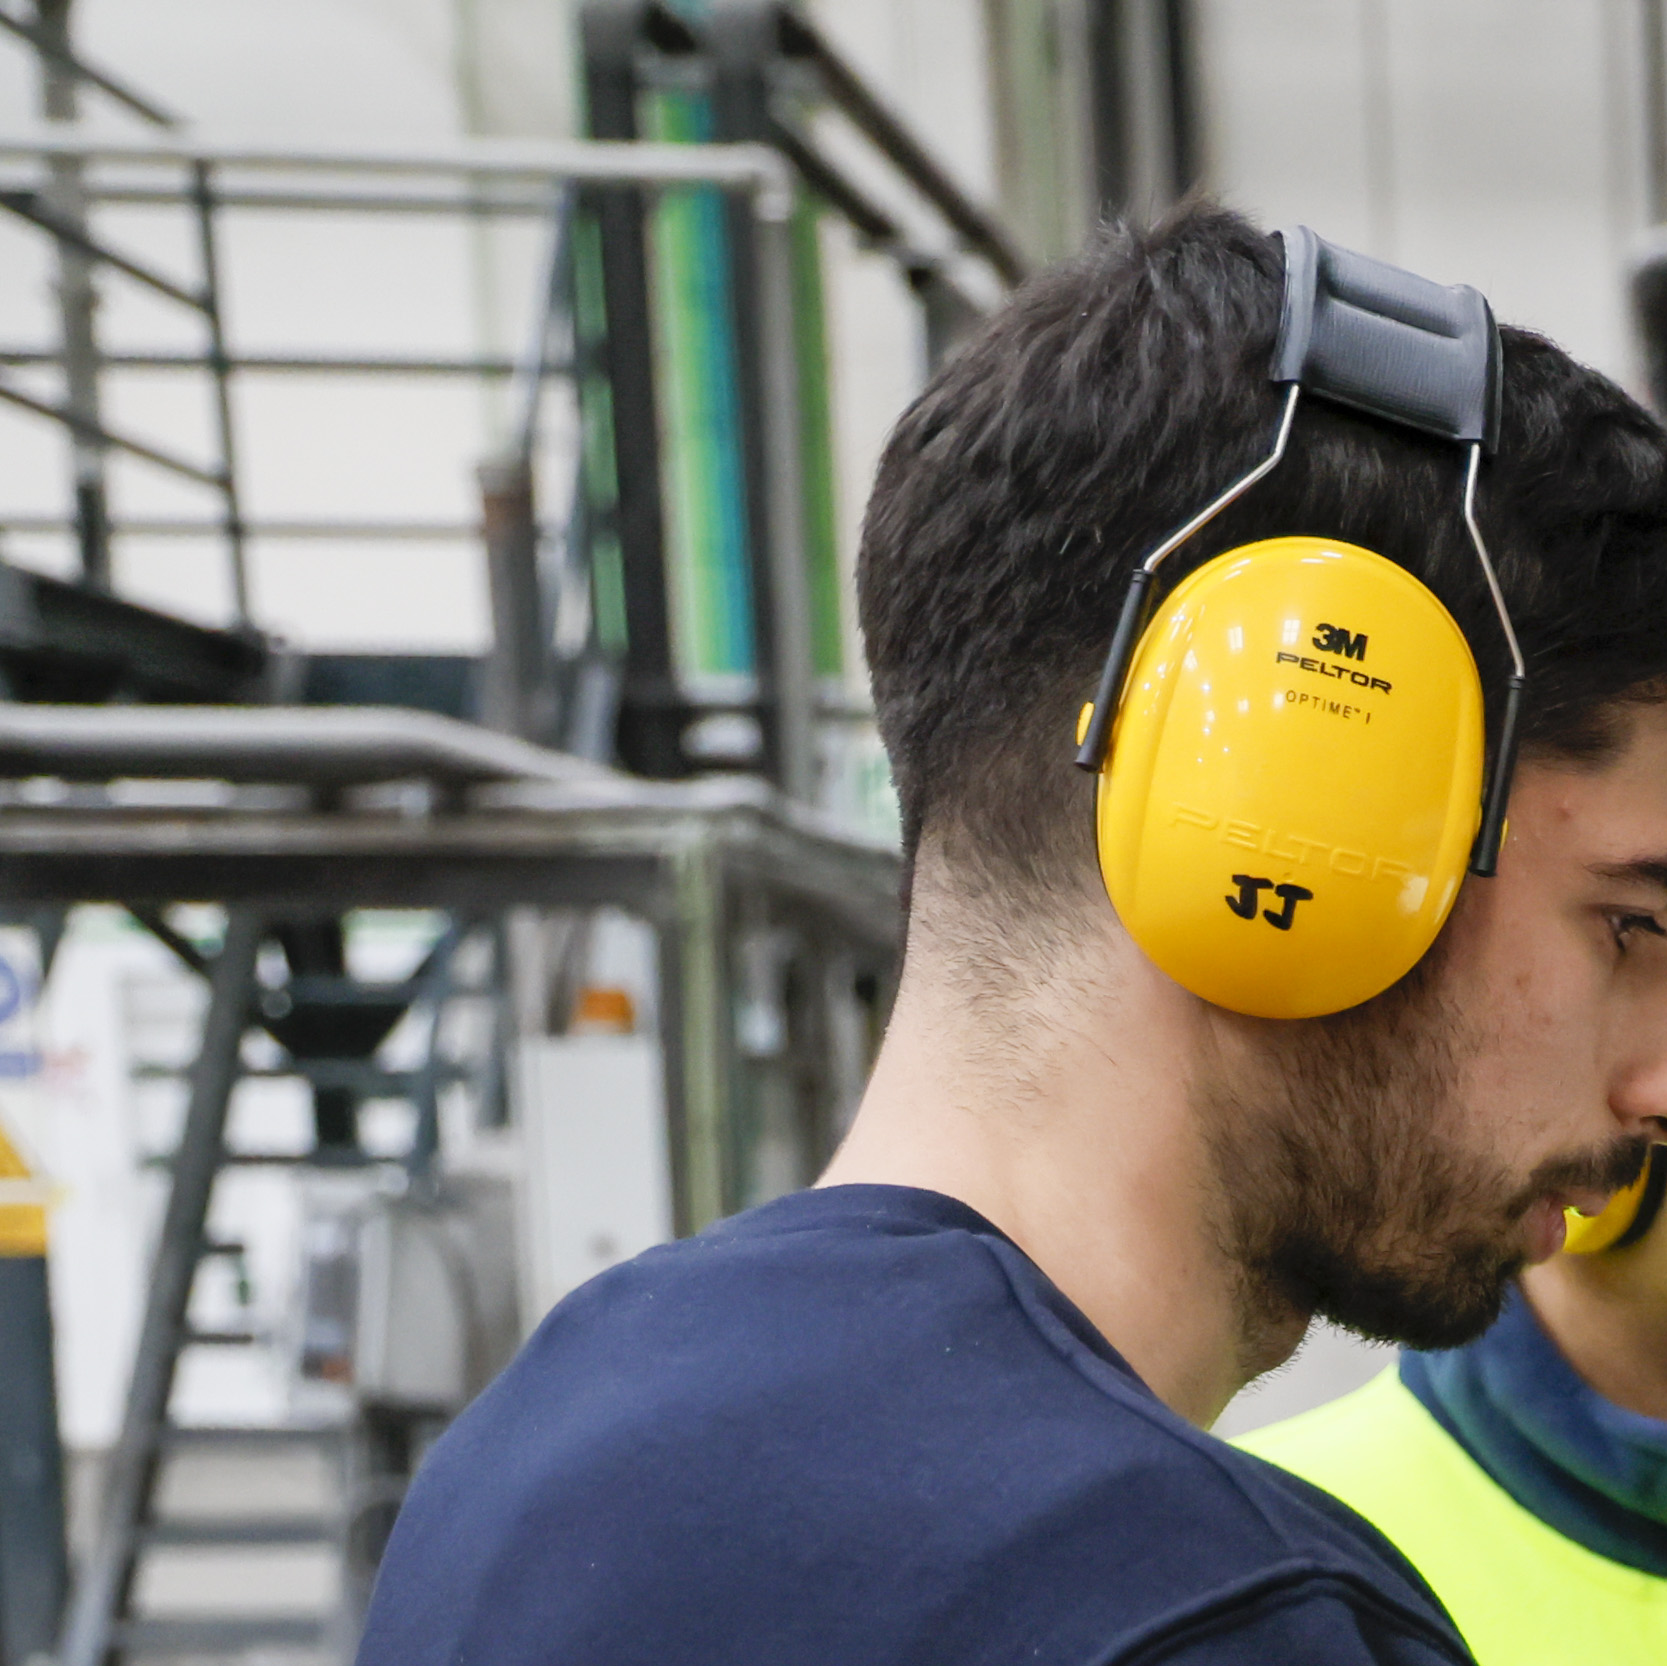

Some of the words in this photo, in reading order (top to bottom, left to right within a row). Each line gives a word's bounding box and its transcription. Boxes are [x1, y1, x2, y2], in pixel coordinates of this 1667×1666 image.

[1312, 622, 1368, 661] 3M
[1275, 651, 1393, 695] PELTOR
[1225, 874, 1314, 931] JJ
